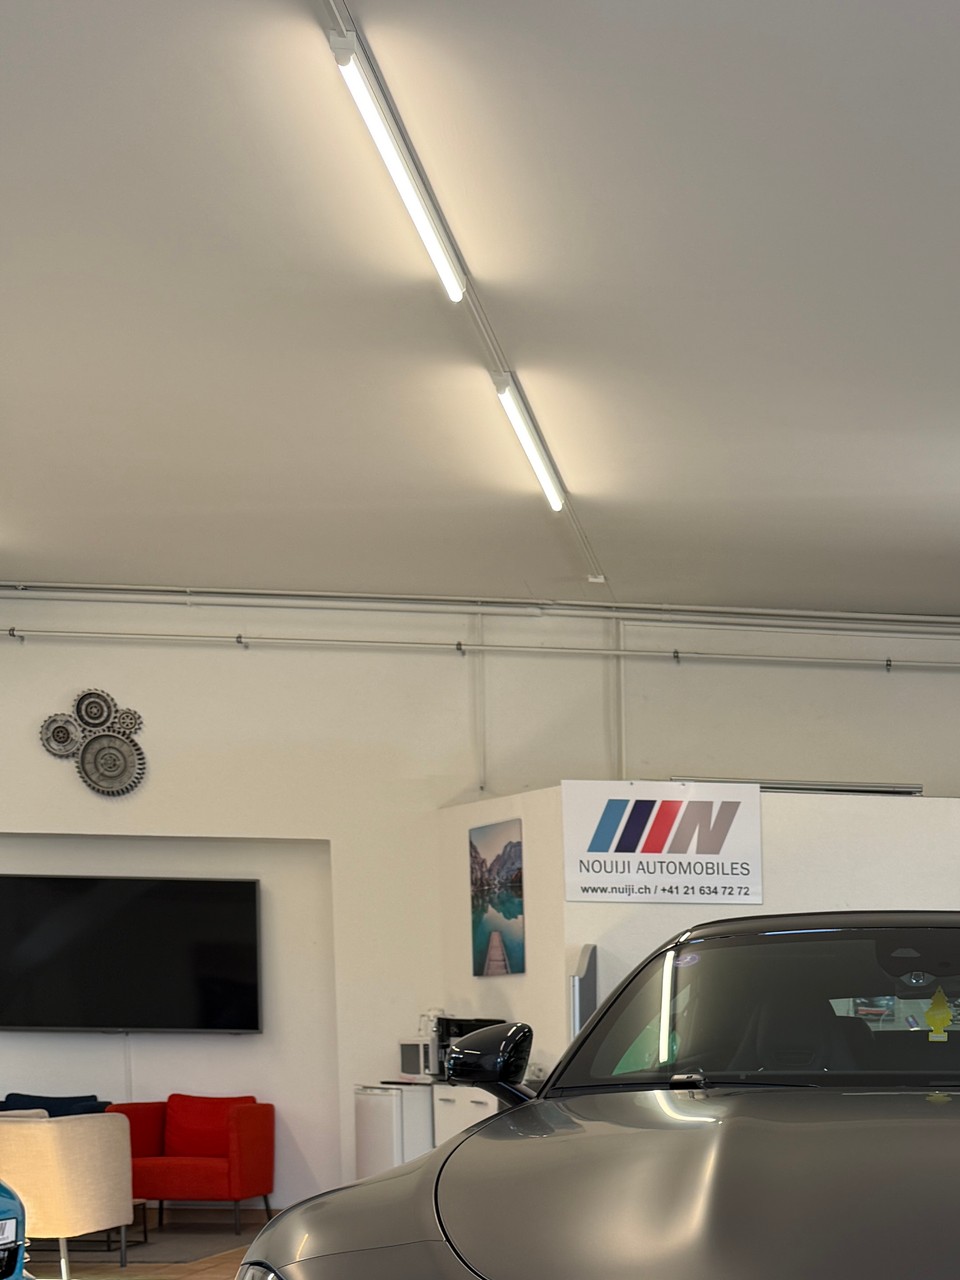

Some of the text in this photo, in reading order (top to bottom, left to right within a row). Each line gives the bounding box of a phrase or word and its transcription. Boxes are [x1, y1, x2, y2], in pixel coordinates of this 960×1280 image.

[579, 860, 750, 876] NOUIJI AUTOMOBILES
[581, 885, 651, 896] www.nuiji.ch
[660, 886, 680, 895] +41
[683, 886, 696, 895] 21
[699, 886, 719, 896] 634
[722, 886, 735, 896] 72
[737, 886, 750, 896] 72
